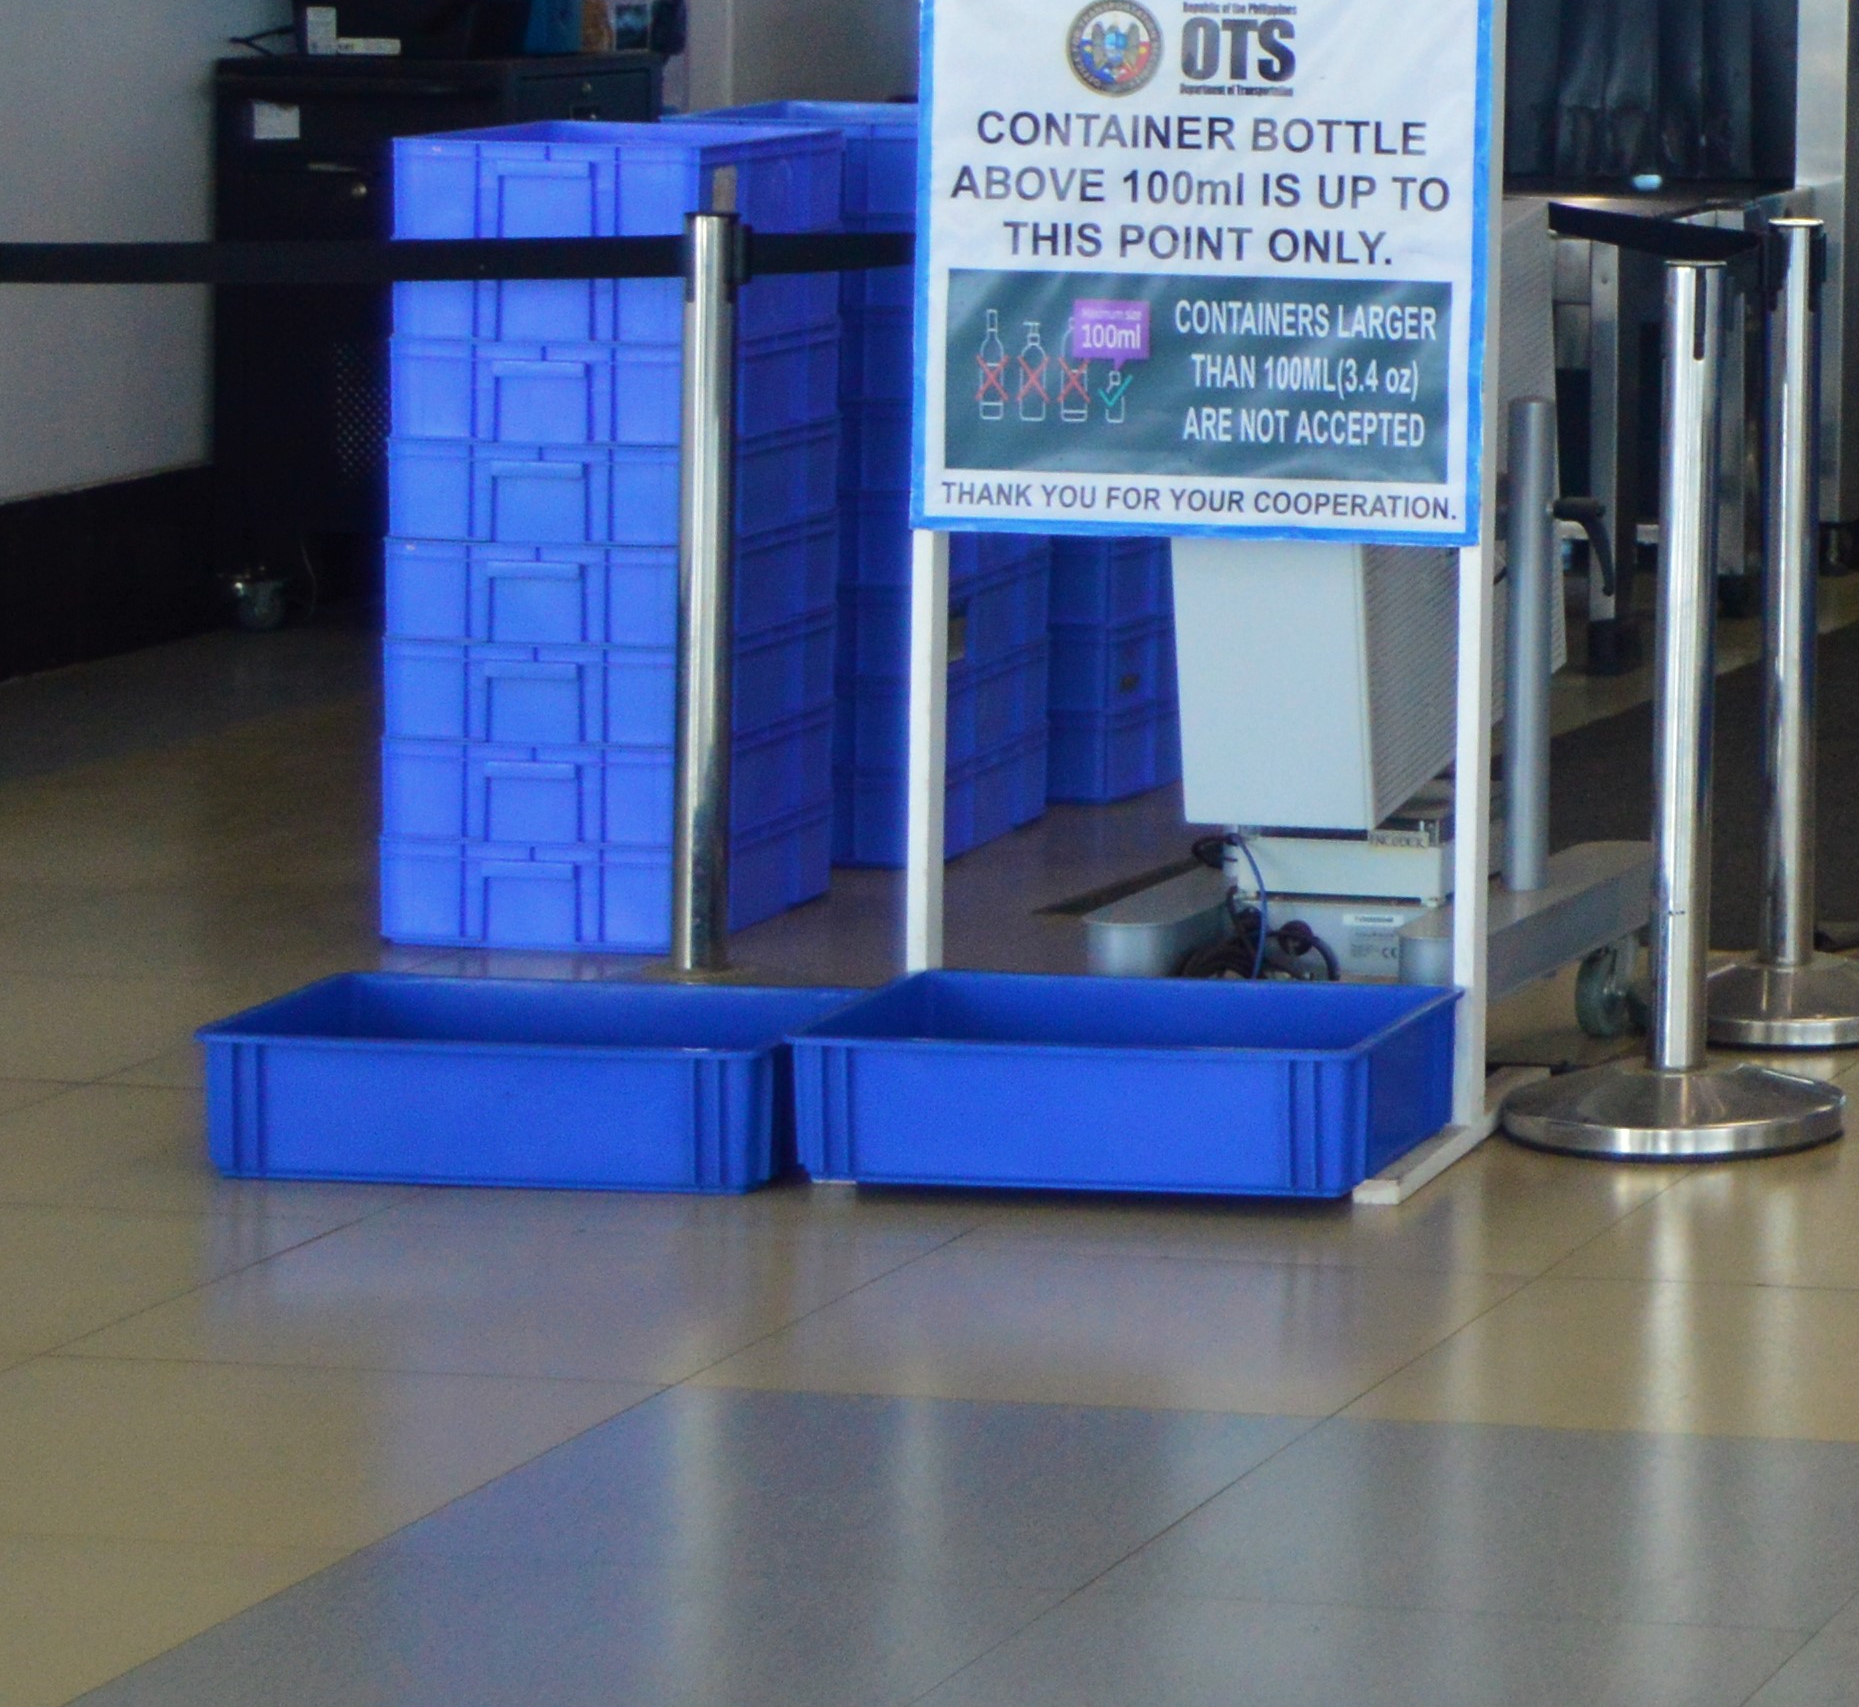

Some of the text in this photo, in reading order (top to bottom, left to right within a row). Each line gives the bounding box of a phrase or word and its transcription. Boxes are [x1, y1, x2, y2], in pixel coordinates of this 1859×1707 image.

[1183, 1, 1220, 14] Republic
[1248, 2, 1297, 16] Philippines
[1181, 16, 1296, 82] OTS
[977, 110, 1427, 156] CONTAINER BOTTLE
[949, 164, 1450, 212] ABOVE 100ml IS UP TO
[1003, 220, 1392, 265] THIS POINT ONLY.
[1081, 323, 1141, 350] 100ml
[1174, 299, 1437, 341] CONTAINERS LARGER
[1190, 353, 1256, 390] THAN
[1385, 359, 1419, 402] oz)
[1183, 406, 1426, 448] ARE NOT ACCEPTED
[941, 480, 1457, 521] THANK YOU FOR YOUR COOPERATION.
